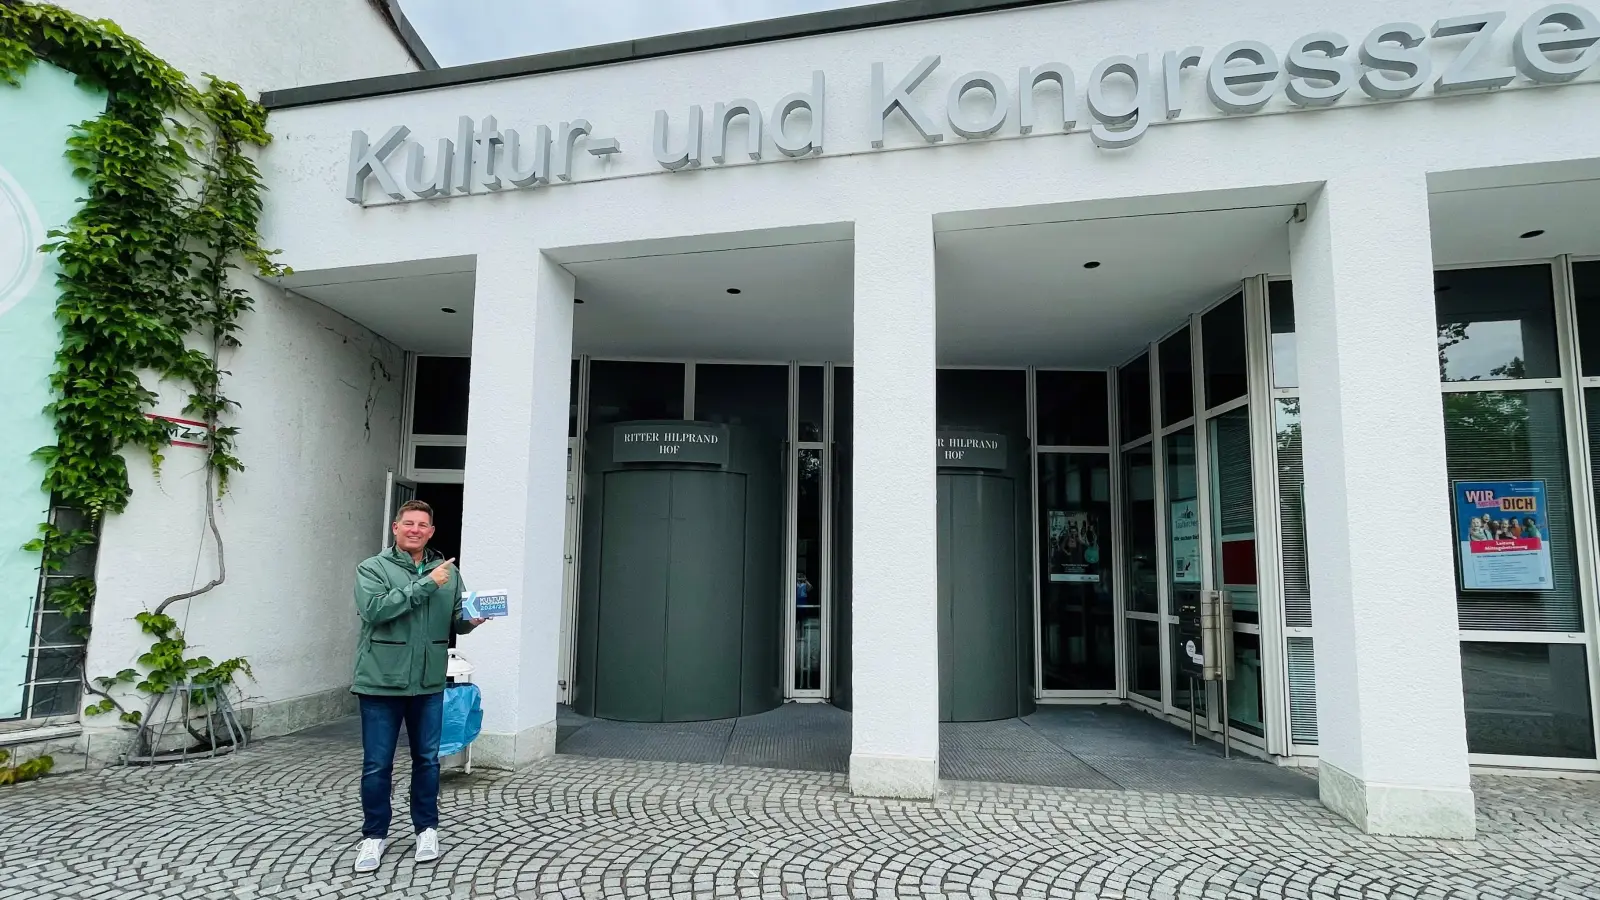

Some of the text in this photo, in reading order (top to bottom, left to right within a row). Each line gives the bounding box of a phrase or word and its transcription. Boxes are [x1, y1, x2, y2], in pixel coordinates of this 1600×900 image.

[346, 3, 1600, 205] Kultur- und Kongressze
[624, 432, 719, 444] RITTER HILPRAND
[949, 438, 998, 450] HILPRAND
[659, 445, 681, 454] HOF
[944, 450, 965, 460] HOF
[1465, 490, 1494, 503] WIR
[1503, 498, 1533, 510] DICH
